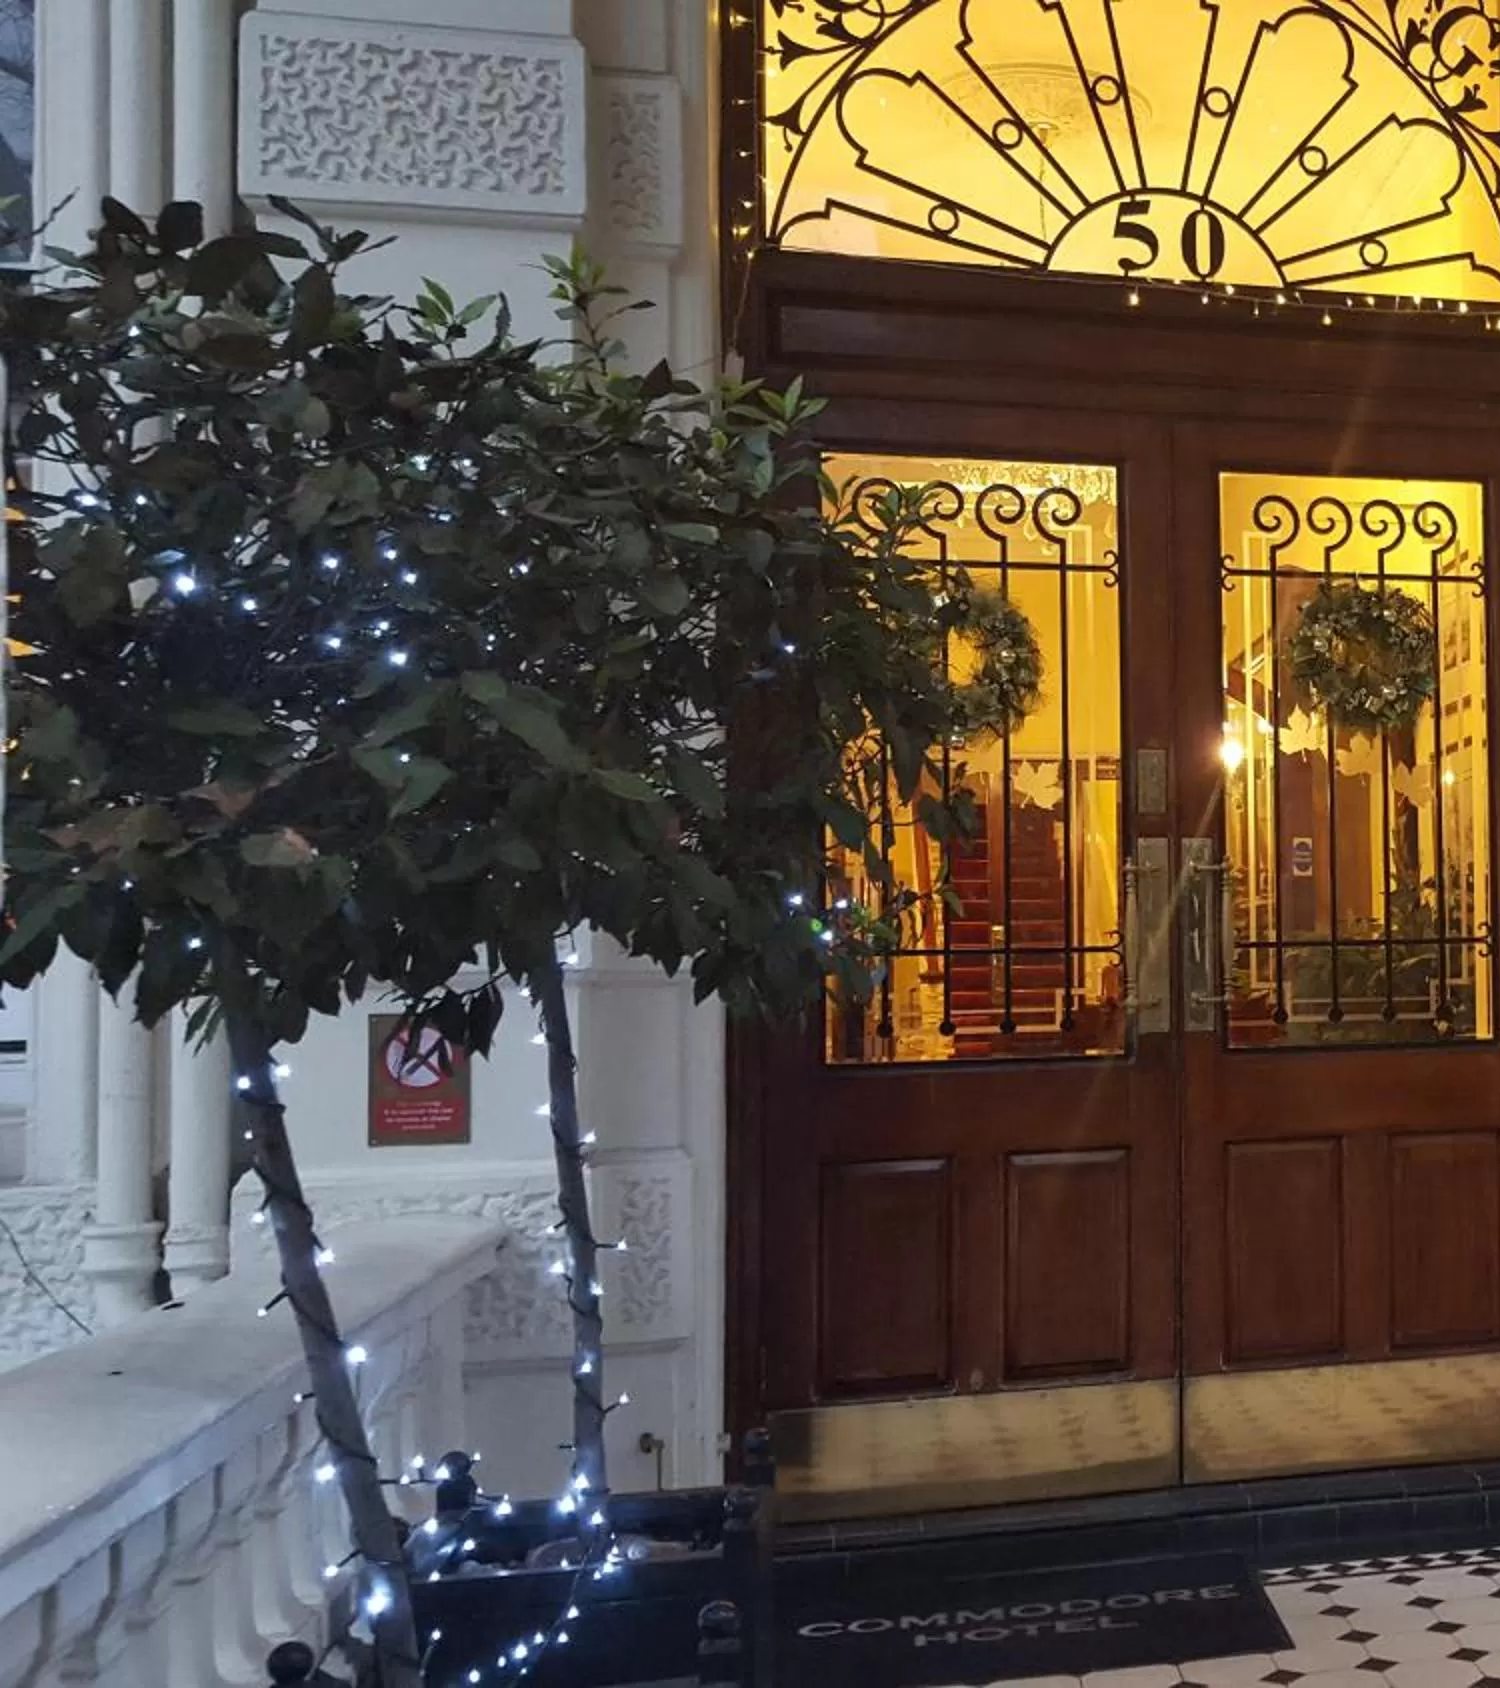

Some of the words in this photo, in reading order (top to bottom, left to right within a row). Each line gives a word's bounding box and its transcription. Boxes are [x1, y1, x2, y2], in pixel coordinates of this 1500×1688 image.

[1113, 199, 1225, 278] 50
[798, 1583, 1241, 1638] COMMODORE
[913, 1614, 1139, 1648] HOTEL
